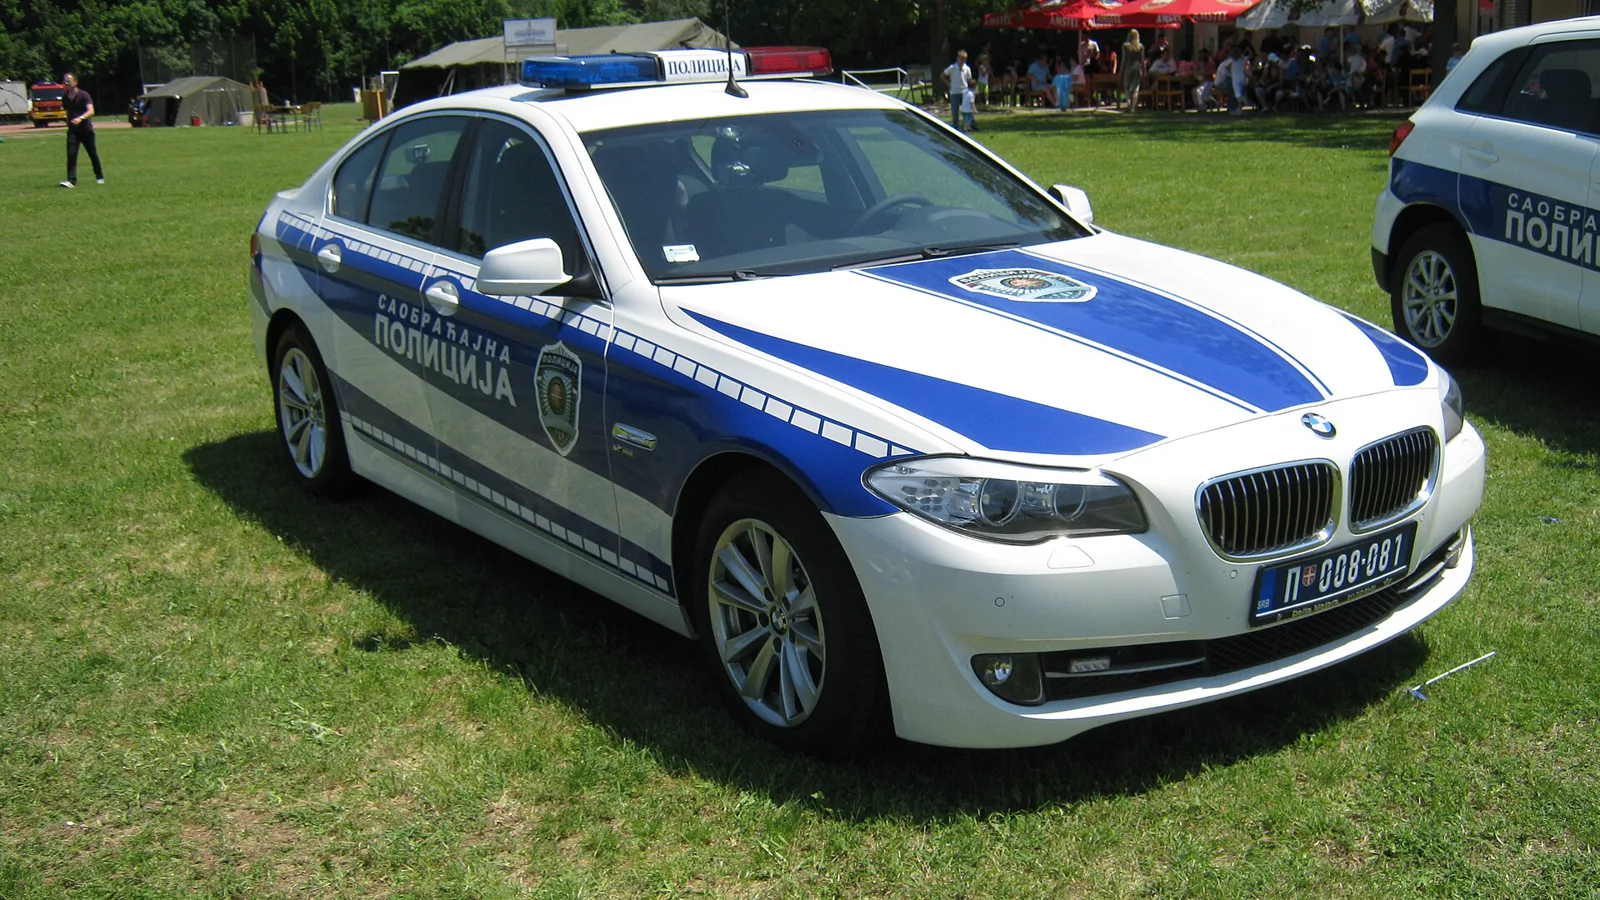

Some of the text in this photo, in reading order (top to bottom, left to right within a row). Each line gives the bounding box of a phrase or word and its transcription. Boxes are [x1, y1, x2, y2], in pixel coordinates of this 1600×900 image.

[1049, 16, 1079, 28] AMSTEL
[668, 59, 741, 75] ПОЛИЦИА
[378, 294, 510, 364] САОБРАЋАЈНА
[375, 312, 517, 407] ПОЛИЦИЈА
[1257, 599, 1270, 610] SRB
